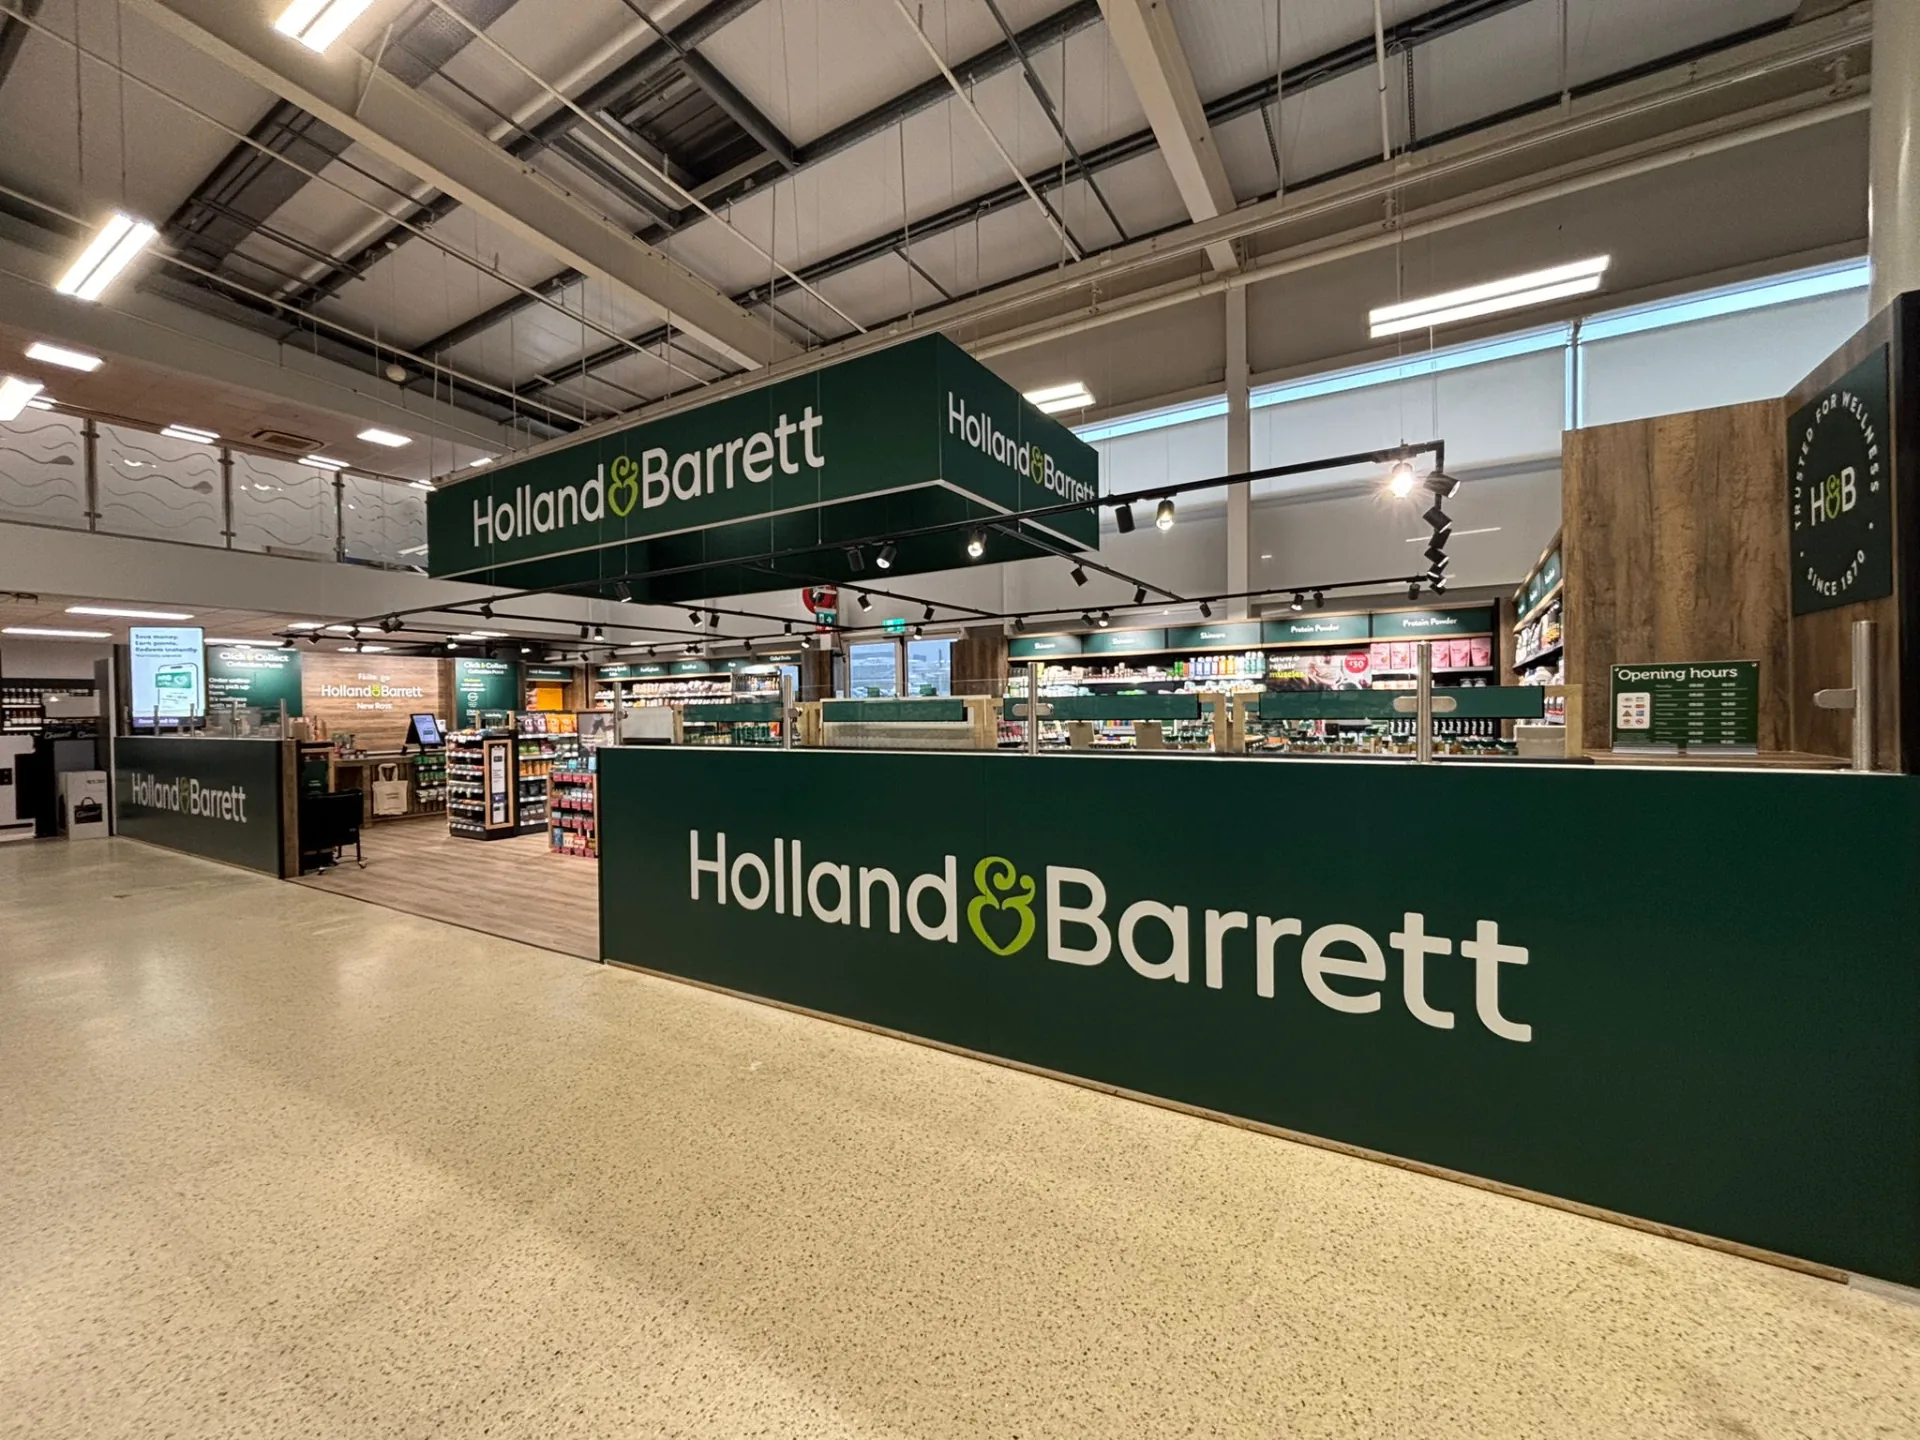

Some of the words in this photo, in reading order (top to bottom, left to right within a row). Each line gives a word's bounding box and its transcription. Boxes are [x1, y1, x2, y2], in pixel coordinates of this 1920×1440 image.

[1794, 427, 1814, 530] TRUSTED
[1815, 393, 1837, 424] FOR
[1841, 391, 1879, 493] WELLNESS
[1810, 466, 1857, 526] H&B
[1807, 566, 1837, 596] SINCE
[1841, 549, 1865, 591] 1870
[1290, 625, 1314, 633] Protein
[1402, 618, 1429, 627] Protein
[1430, 617, 1457, 626] Powder
[1618, 669, 1686, 682] Opening
[1690, 667, 1738, 679] hours
[690, 829, 1532, 1044] Holland&Barrett
